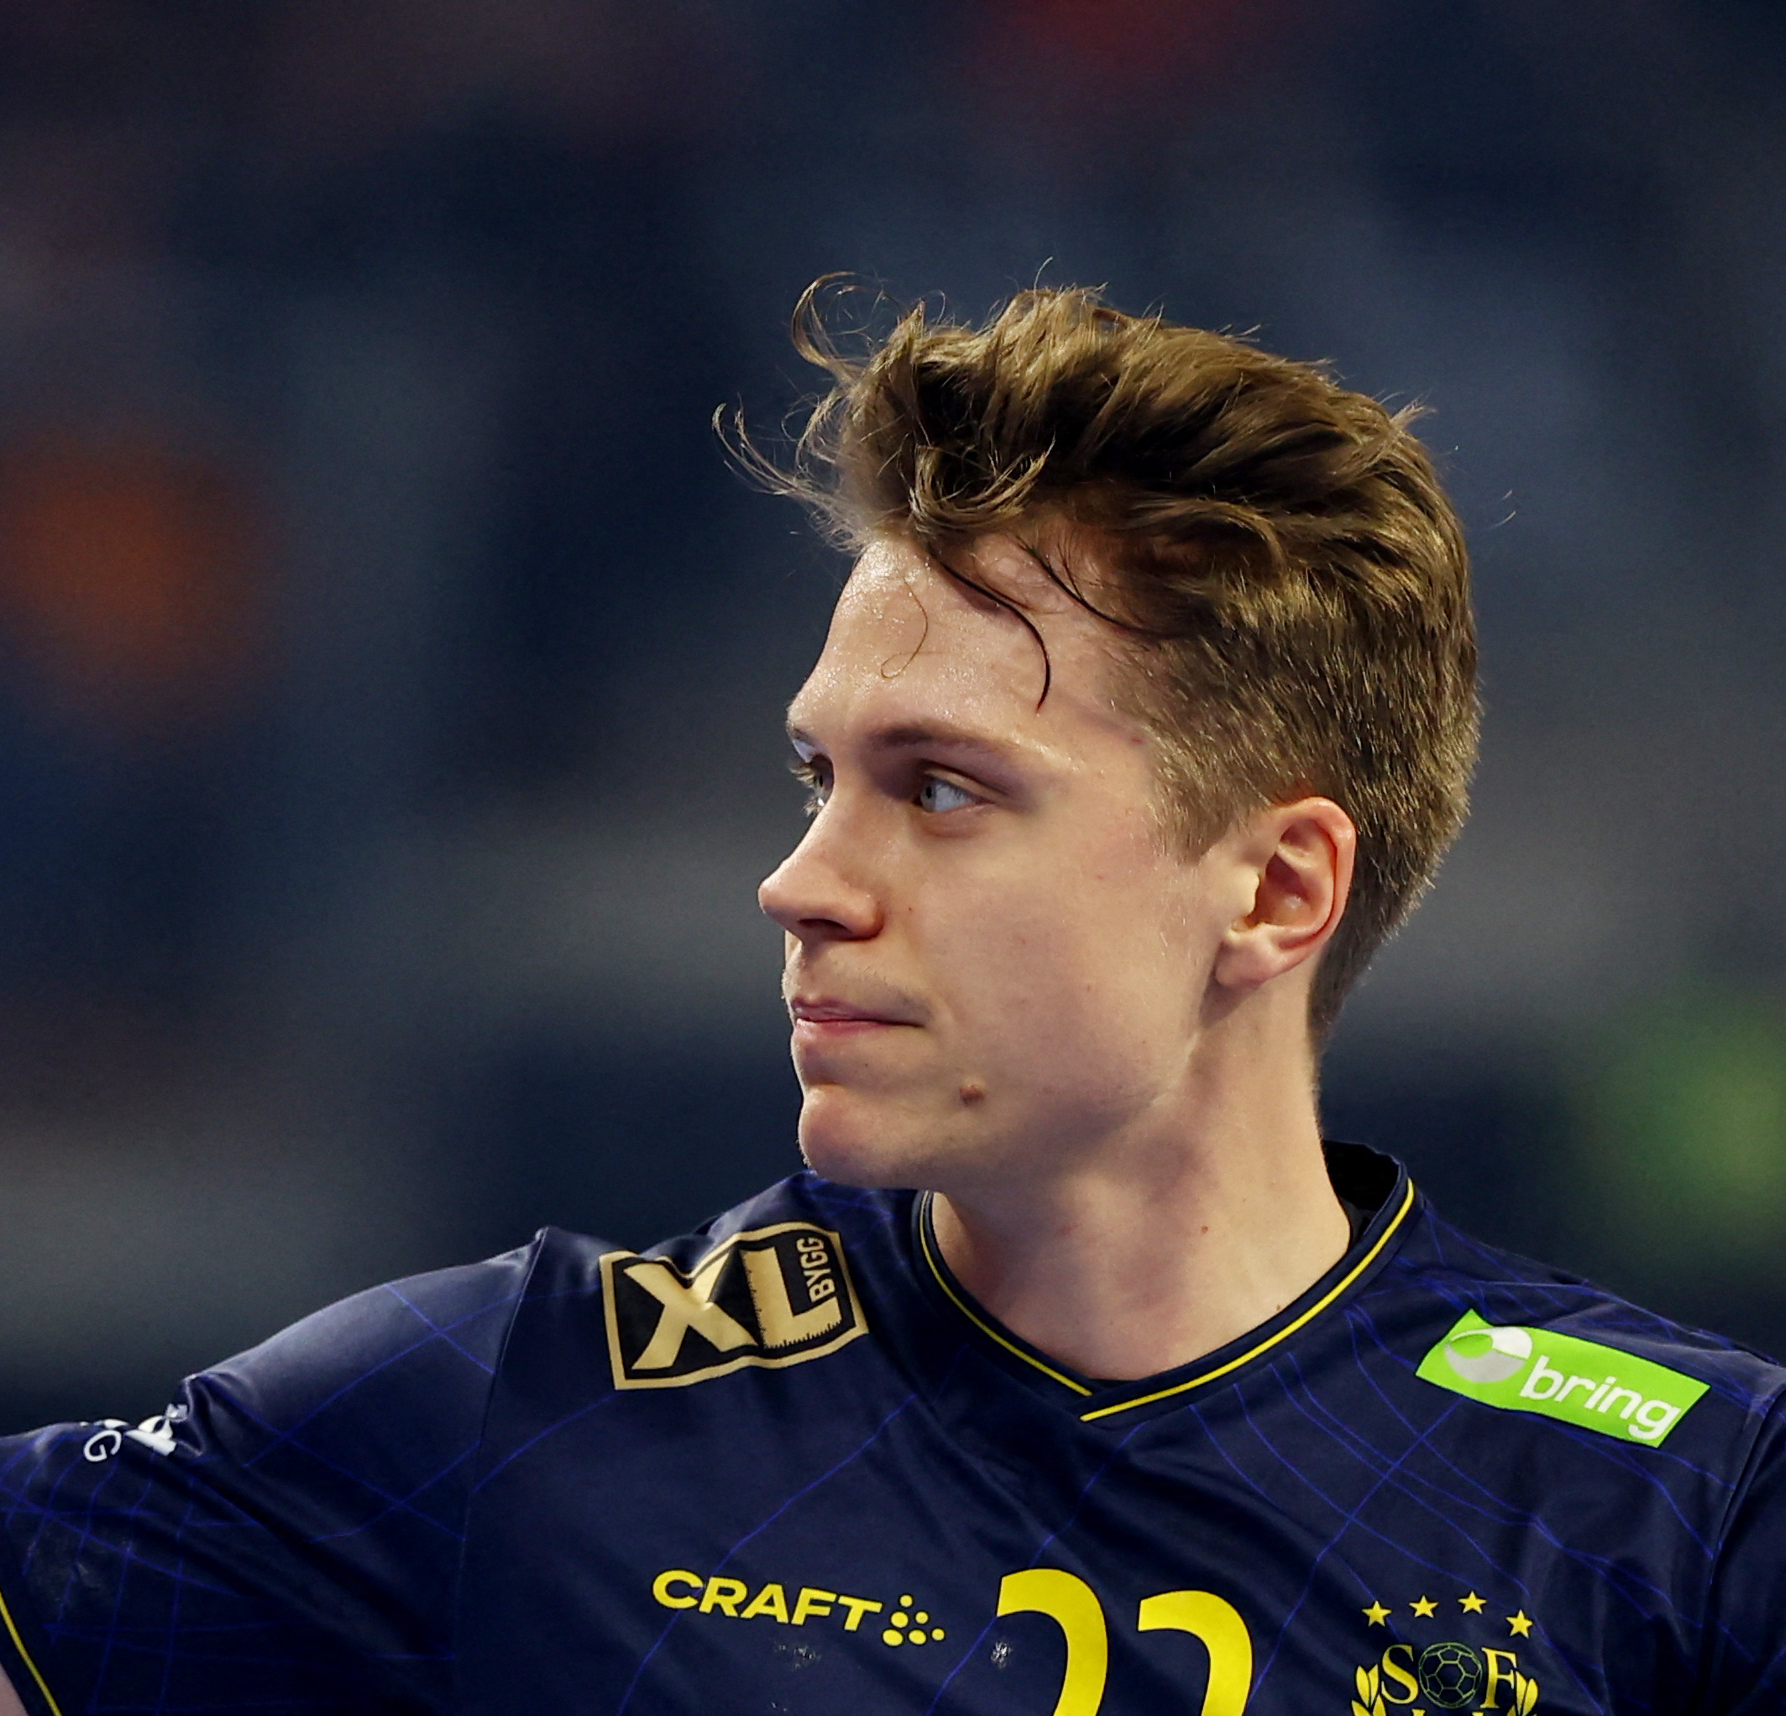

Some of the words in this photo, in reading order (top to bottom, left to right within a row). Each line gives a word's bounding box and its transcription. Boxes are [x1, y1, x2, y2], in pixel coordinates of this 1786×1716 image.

[795, 1235, 838, 1303] BYGG
[622, 1245, 844, 1371] XL
[1519, 1355, 1682, 1441] bring
[651, 1569, 883, 1632] CRAFT
